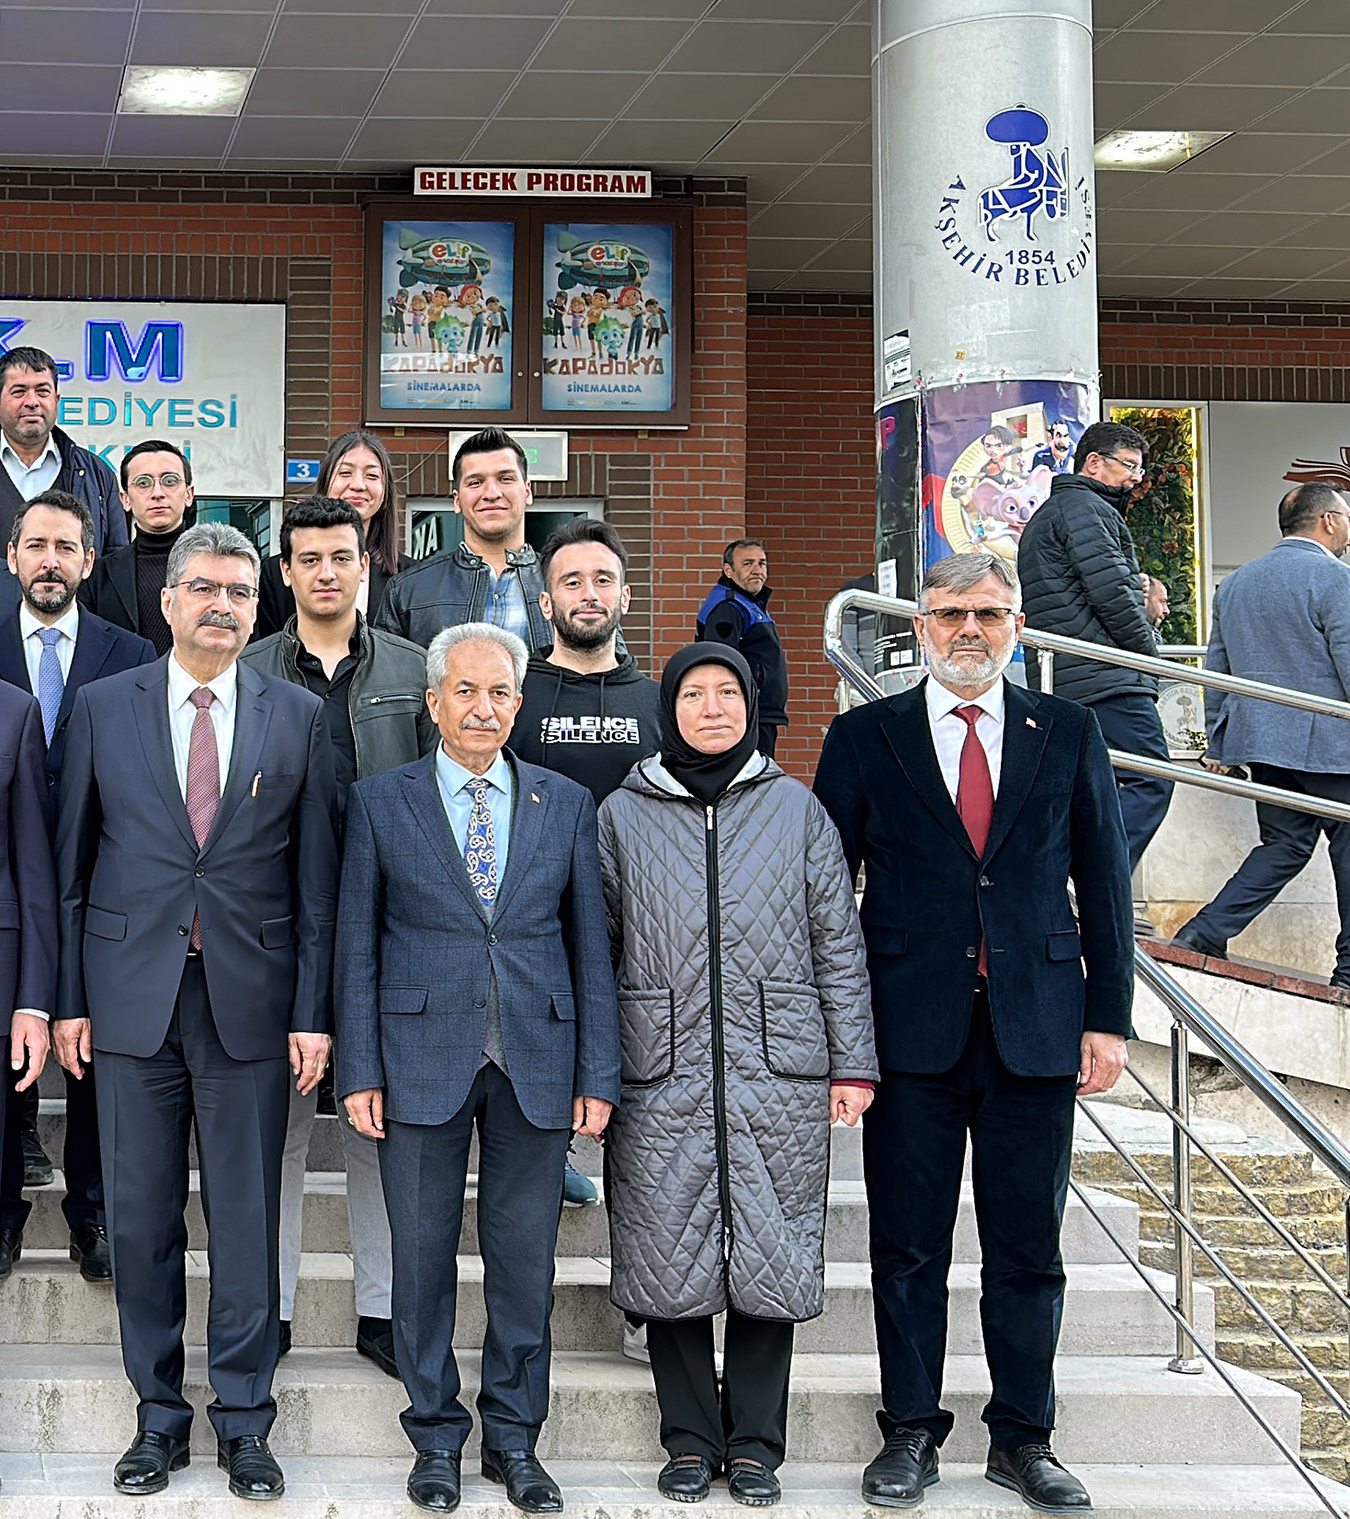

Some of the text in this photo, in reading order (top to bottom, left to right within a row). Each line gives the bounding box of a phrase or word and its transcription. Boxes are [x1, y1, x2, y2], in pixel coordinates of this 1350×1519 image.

[419, 171, 647, 194] GELECEK PROGRAM
[934, 174, 1092, 287] AKŞEHİR BELEDİSİ
[1005, 250, 1056, 266] 1854
[407, 380, 482, 392] SİNEMALARDA
[567, 381, 642, 393] SİNEMALARDA
[296, 463, 310, 478] 3
[541, 716, 639, 731] SILENCE
[540, 729, 640, 744] SILENCE
